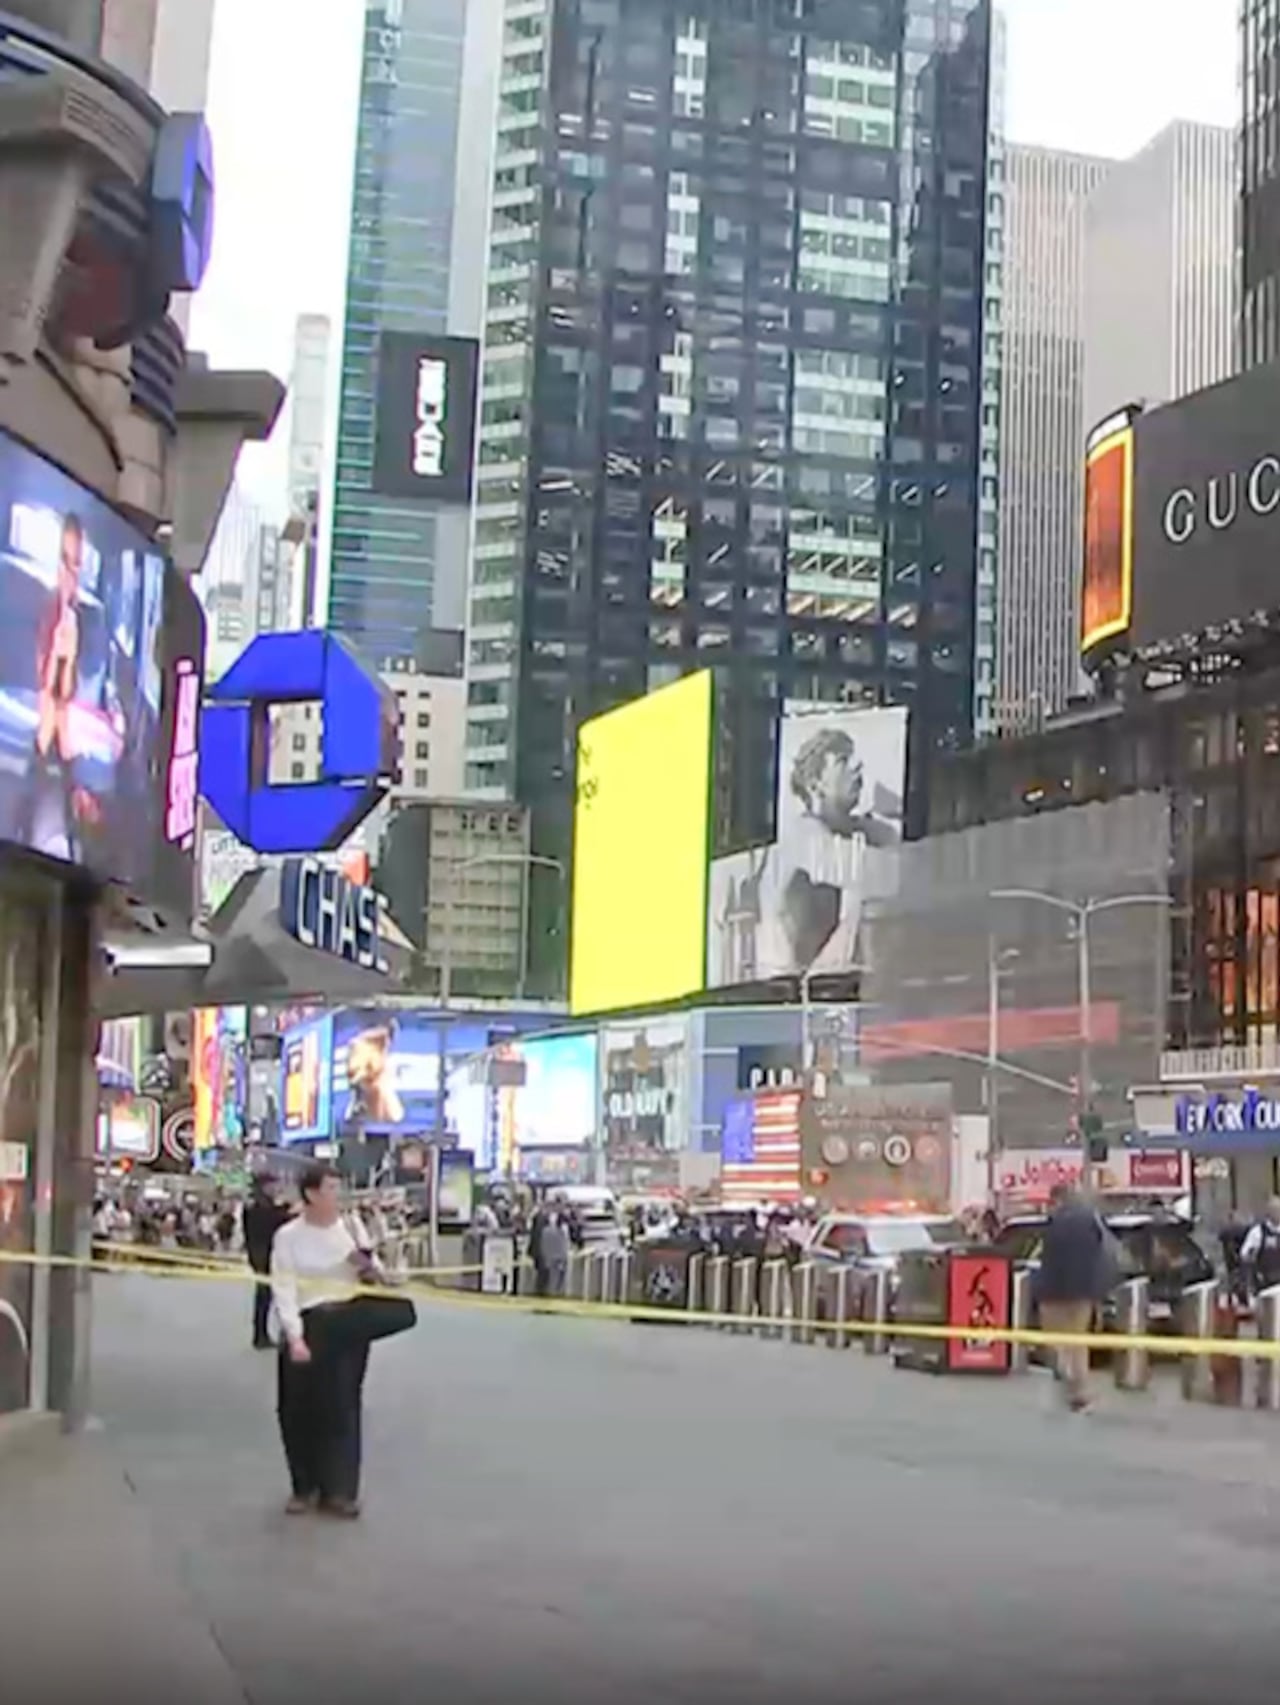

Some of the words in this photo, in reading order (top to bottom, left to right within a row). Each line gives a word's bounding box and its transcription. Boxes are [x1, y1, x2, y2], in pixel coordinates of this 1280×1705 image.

[296, 855, 390, 974] CHASE
[1176, 1094, 1208, 1133] EW
[1208, 1093, 1245, 1132] ORK
